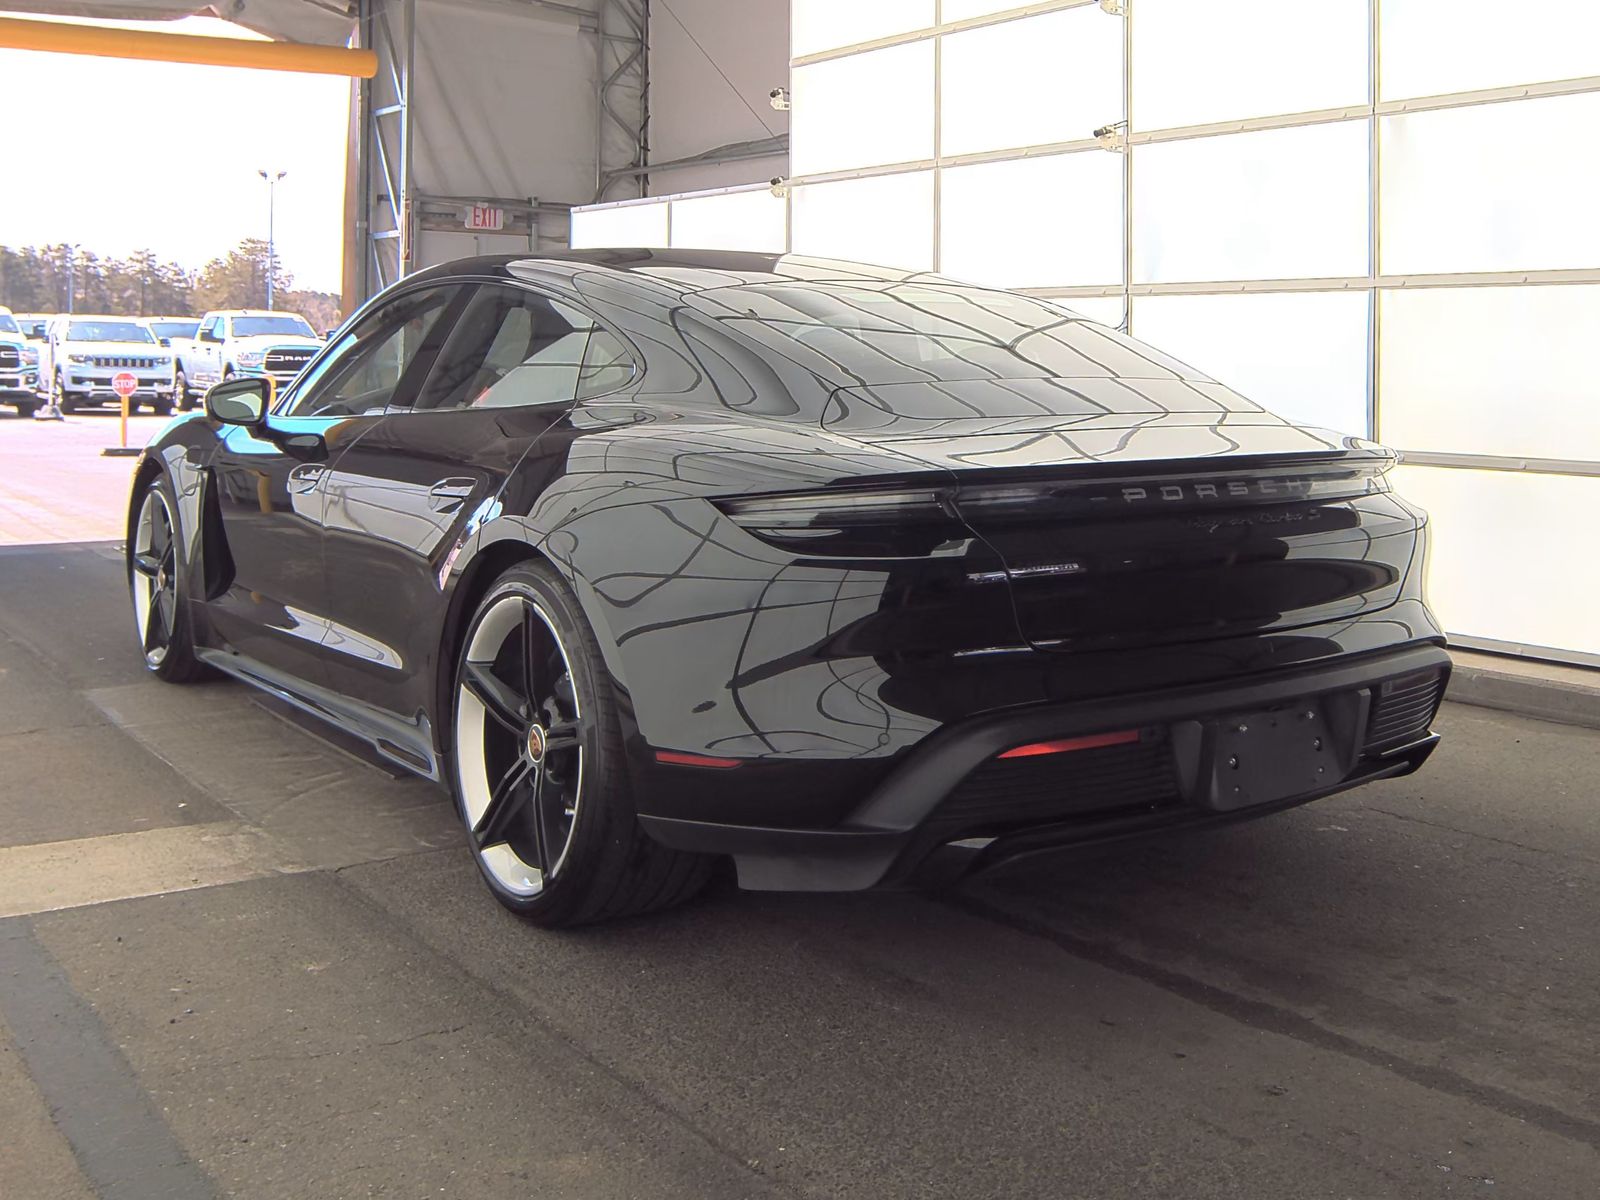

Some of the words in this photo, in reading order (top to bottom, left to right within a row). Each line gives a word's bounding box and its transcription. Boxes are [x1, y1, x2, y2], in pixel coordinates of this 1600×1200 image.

[473, 207, 497, 228] EXIT
[114, 379, 136, 389] STOP
[1121, 478, 1318, 503] PORSCH
